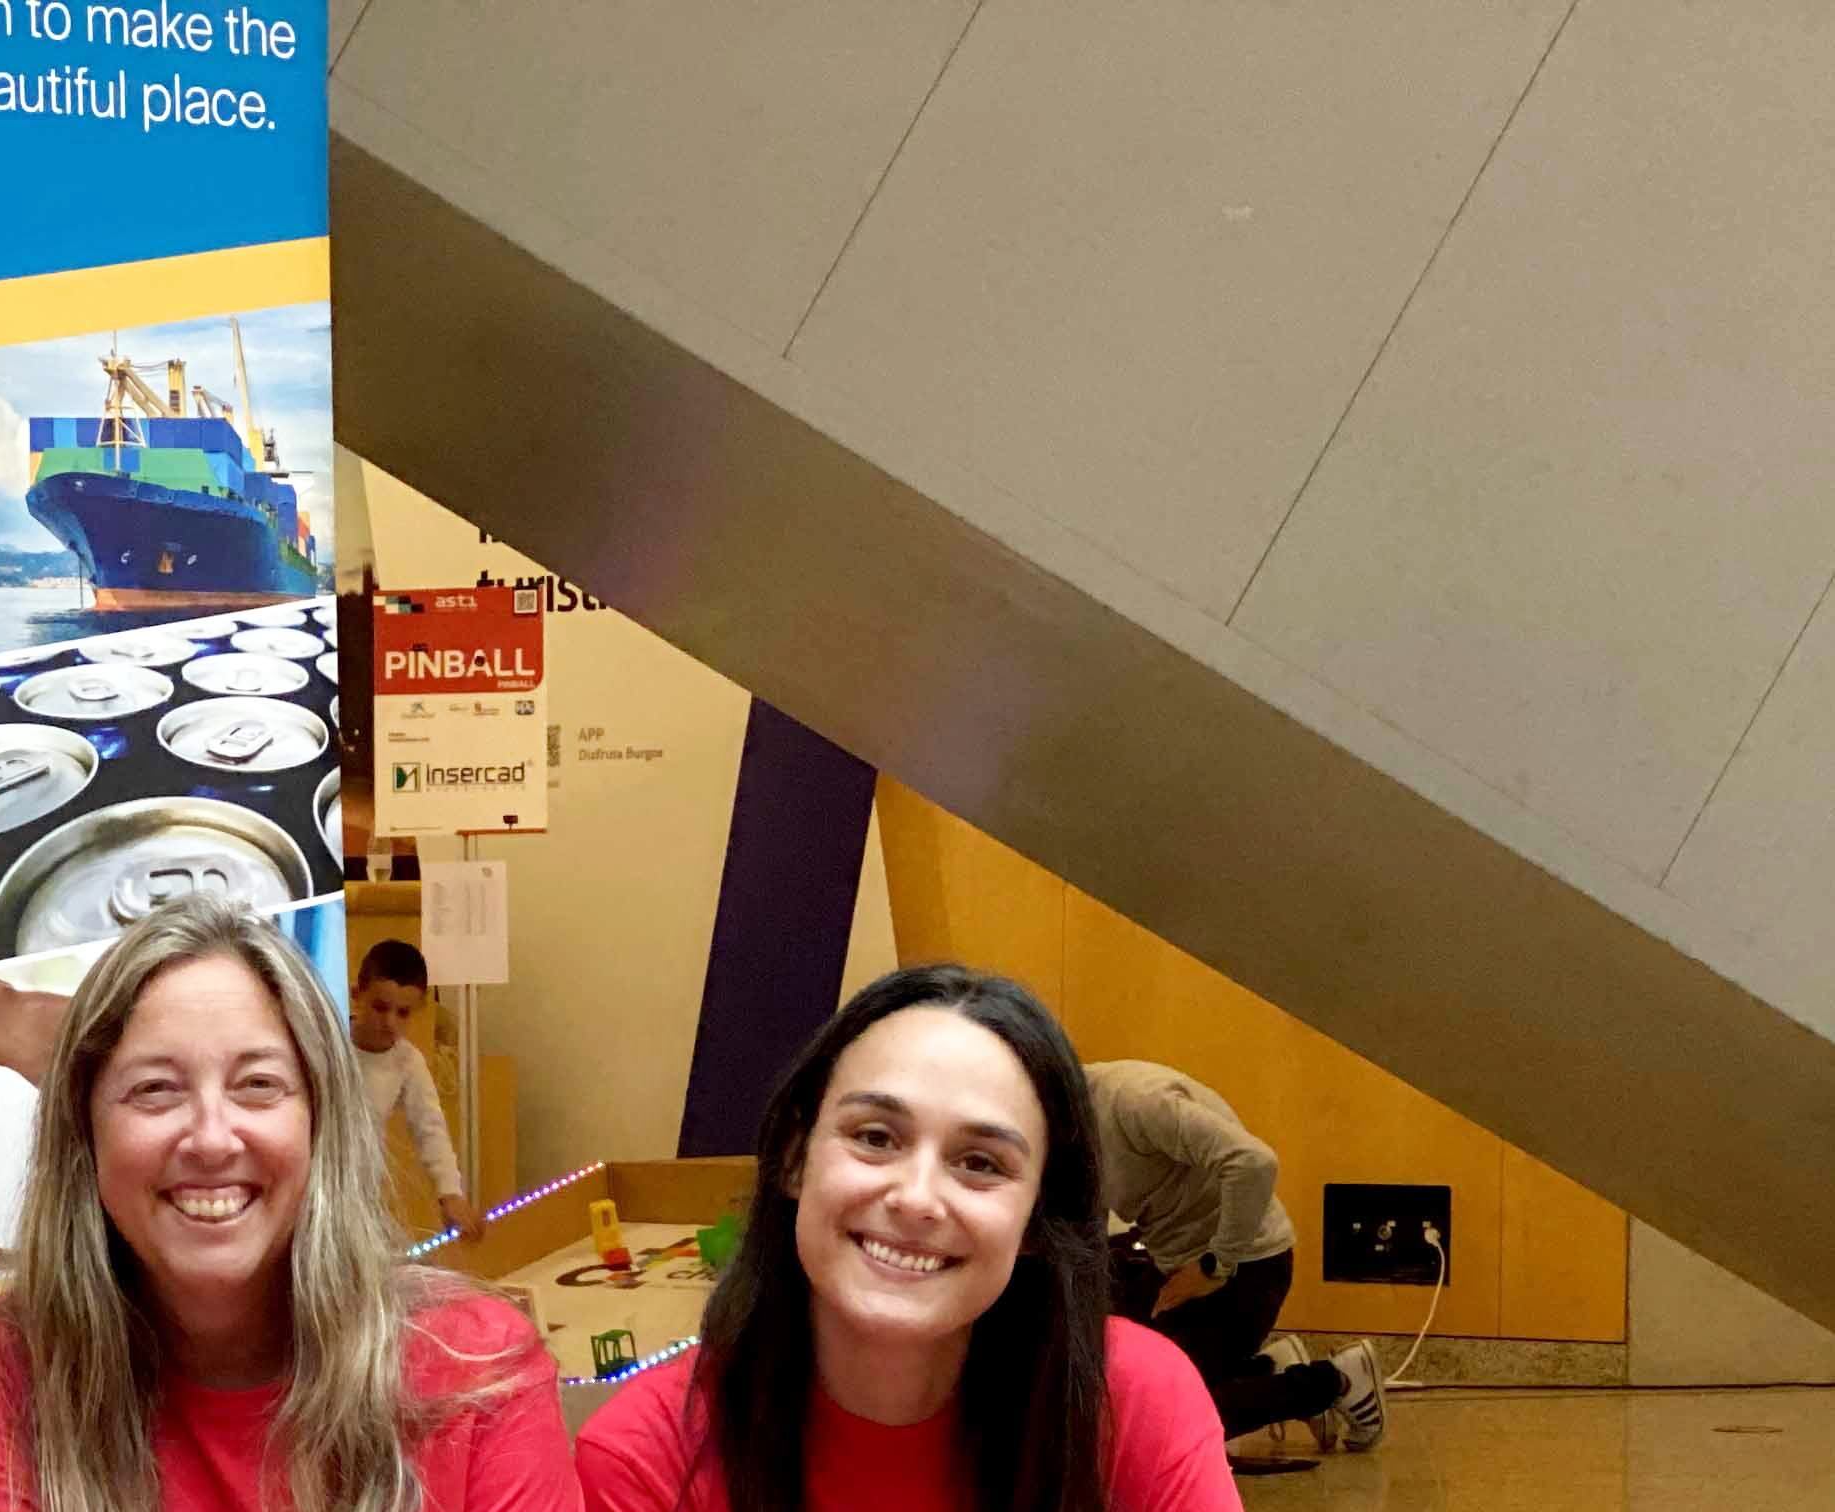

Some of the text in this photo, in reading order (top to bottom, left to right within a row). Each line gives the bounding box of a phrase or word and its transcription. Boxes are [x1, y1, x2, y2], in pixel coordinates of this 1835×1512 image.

[29, 0, 72, 41] to
[86, 0, 213, 52] make
[224, 6, 296, 60] the
[142, 73, 276, 132] place.
[384, 648, 536, 680] PINBALL
[577, 727, 606, 742] APP
